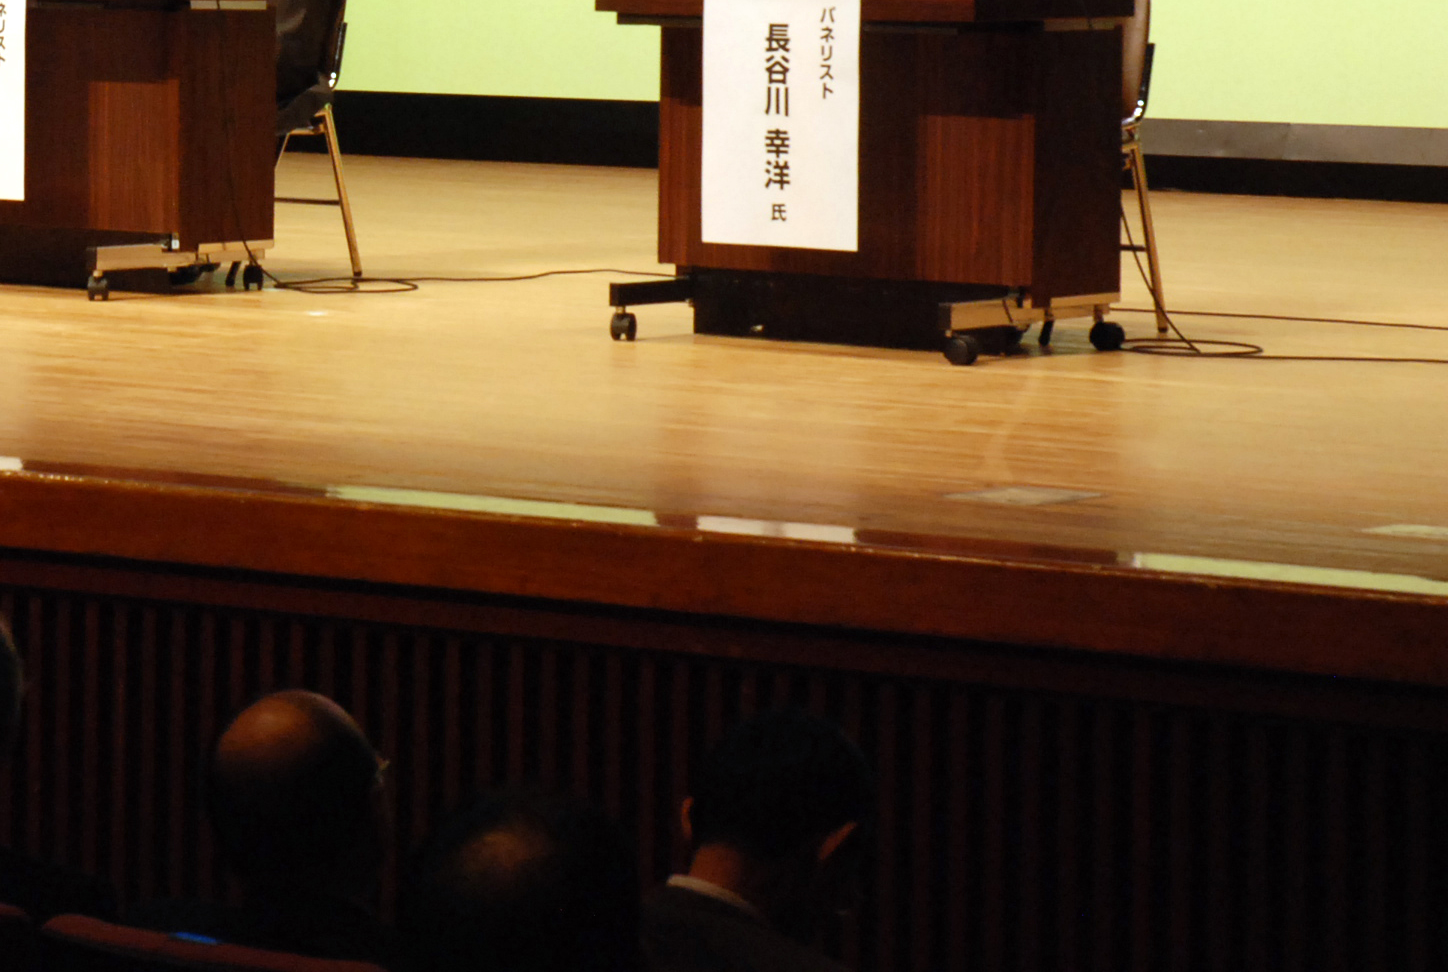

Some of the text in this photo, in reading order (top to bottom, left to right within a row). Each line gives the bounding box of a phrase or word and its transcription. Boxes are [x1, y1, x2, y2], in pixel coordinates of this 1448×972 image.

[765, 23, 791, 222] 長谷川 幸洋 氏
